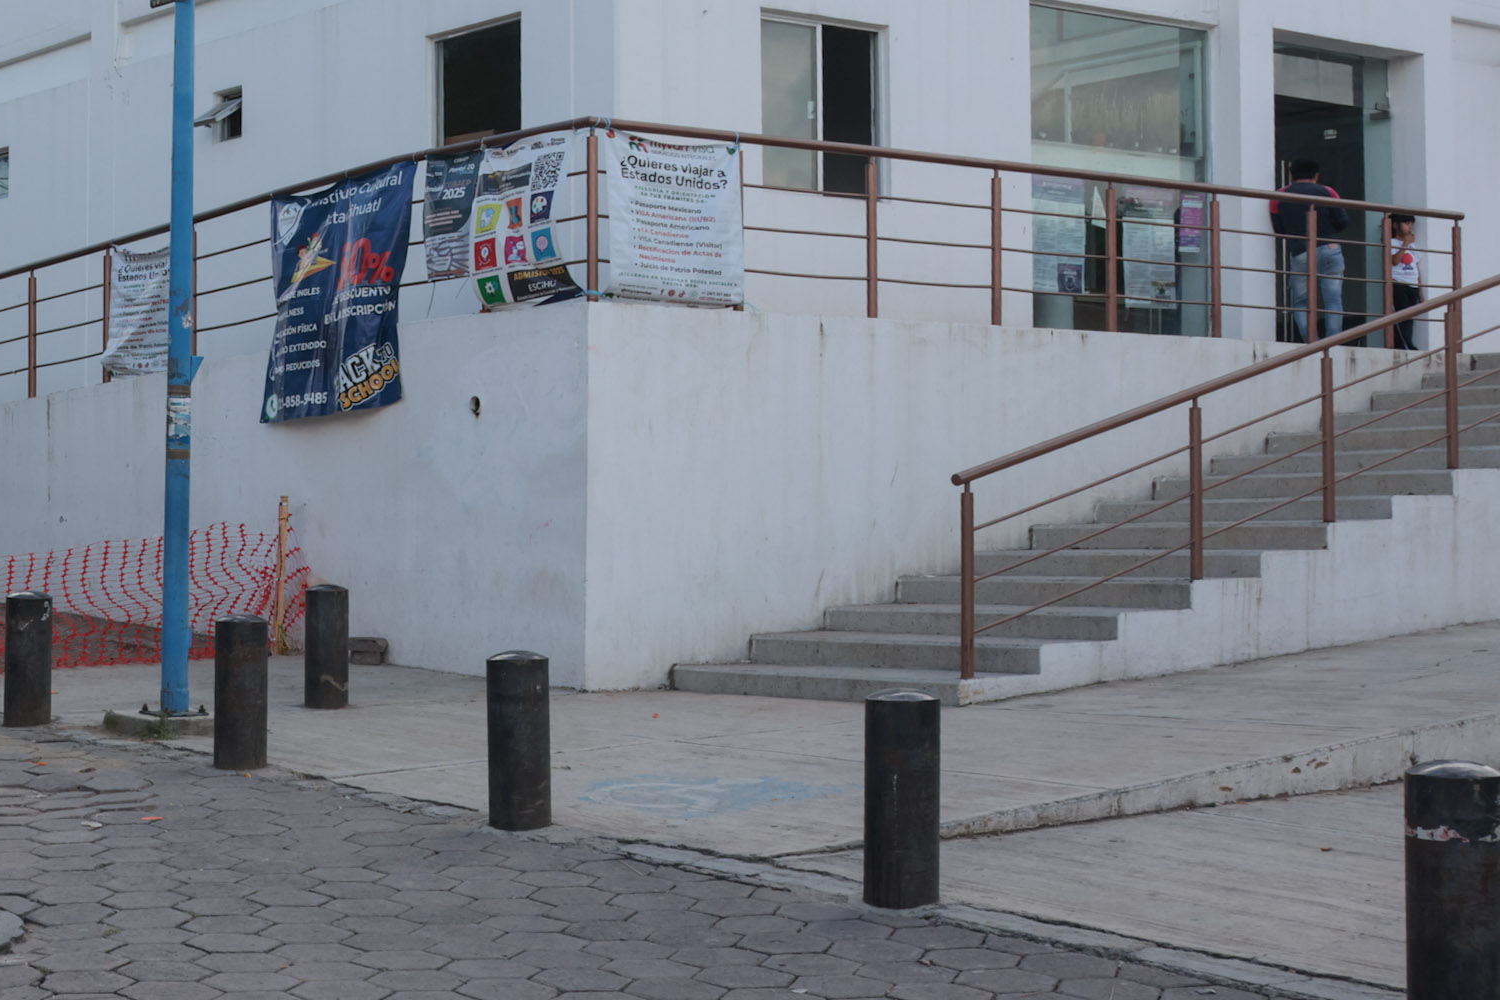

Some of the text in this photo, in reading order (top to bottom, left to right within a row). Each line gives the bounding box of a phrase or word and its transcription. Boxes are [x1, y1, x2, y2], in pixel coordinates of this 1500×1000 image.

[620, 155, 726, 178] ¿Quieres viajar a
[621, 167, 728, 190] Estados Unidos?
[442, 187, 466, 200] 2025
[635, 200, 702, 214] Pasaporte Mexicano
[636, 217, 710, 231] Pasaporte Americano
[653, 238, 694, 248] Canadiense
[118, 273, 148, 283] Estados
[692, 267, 723, 276] Potestad
[296, 286, 321, 298] INGLES
[297, 322, 318, 334] FÍSICA
[376, 341, 394, 362] TO
[285, 358, 321, 372] REDUCIDOS
